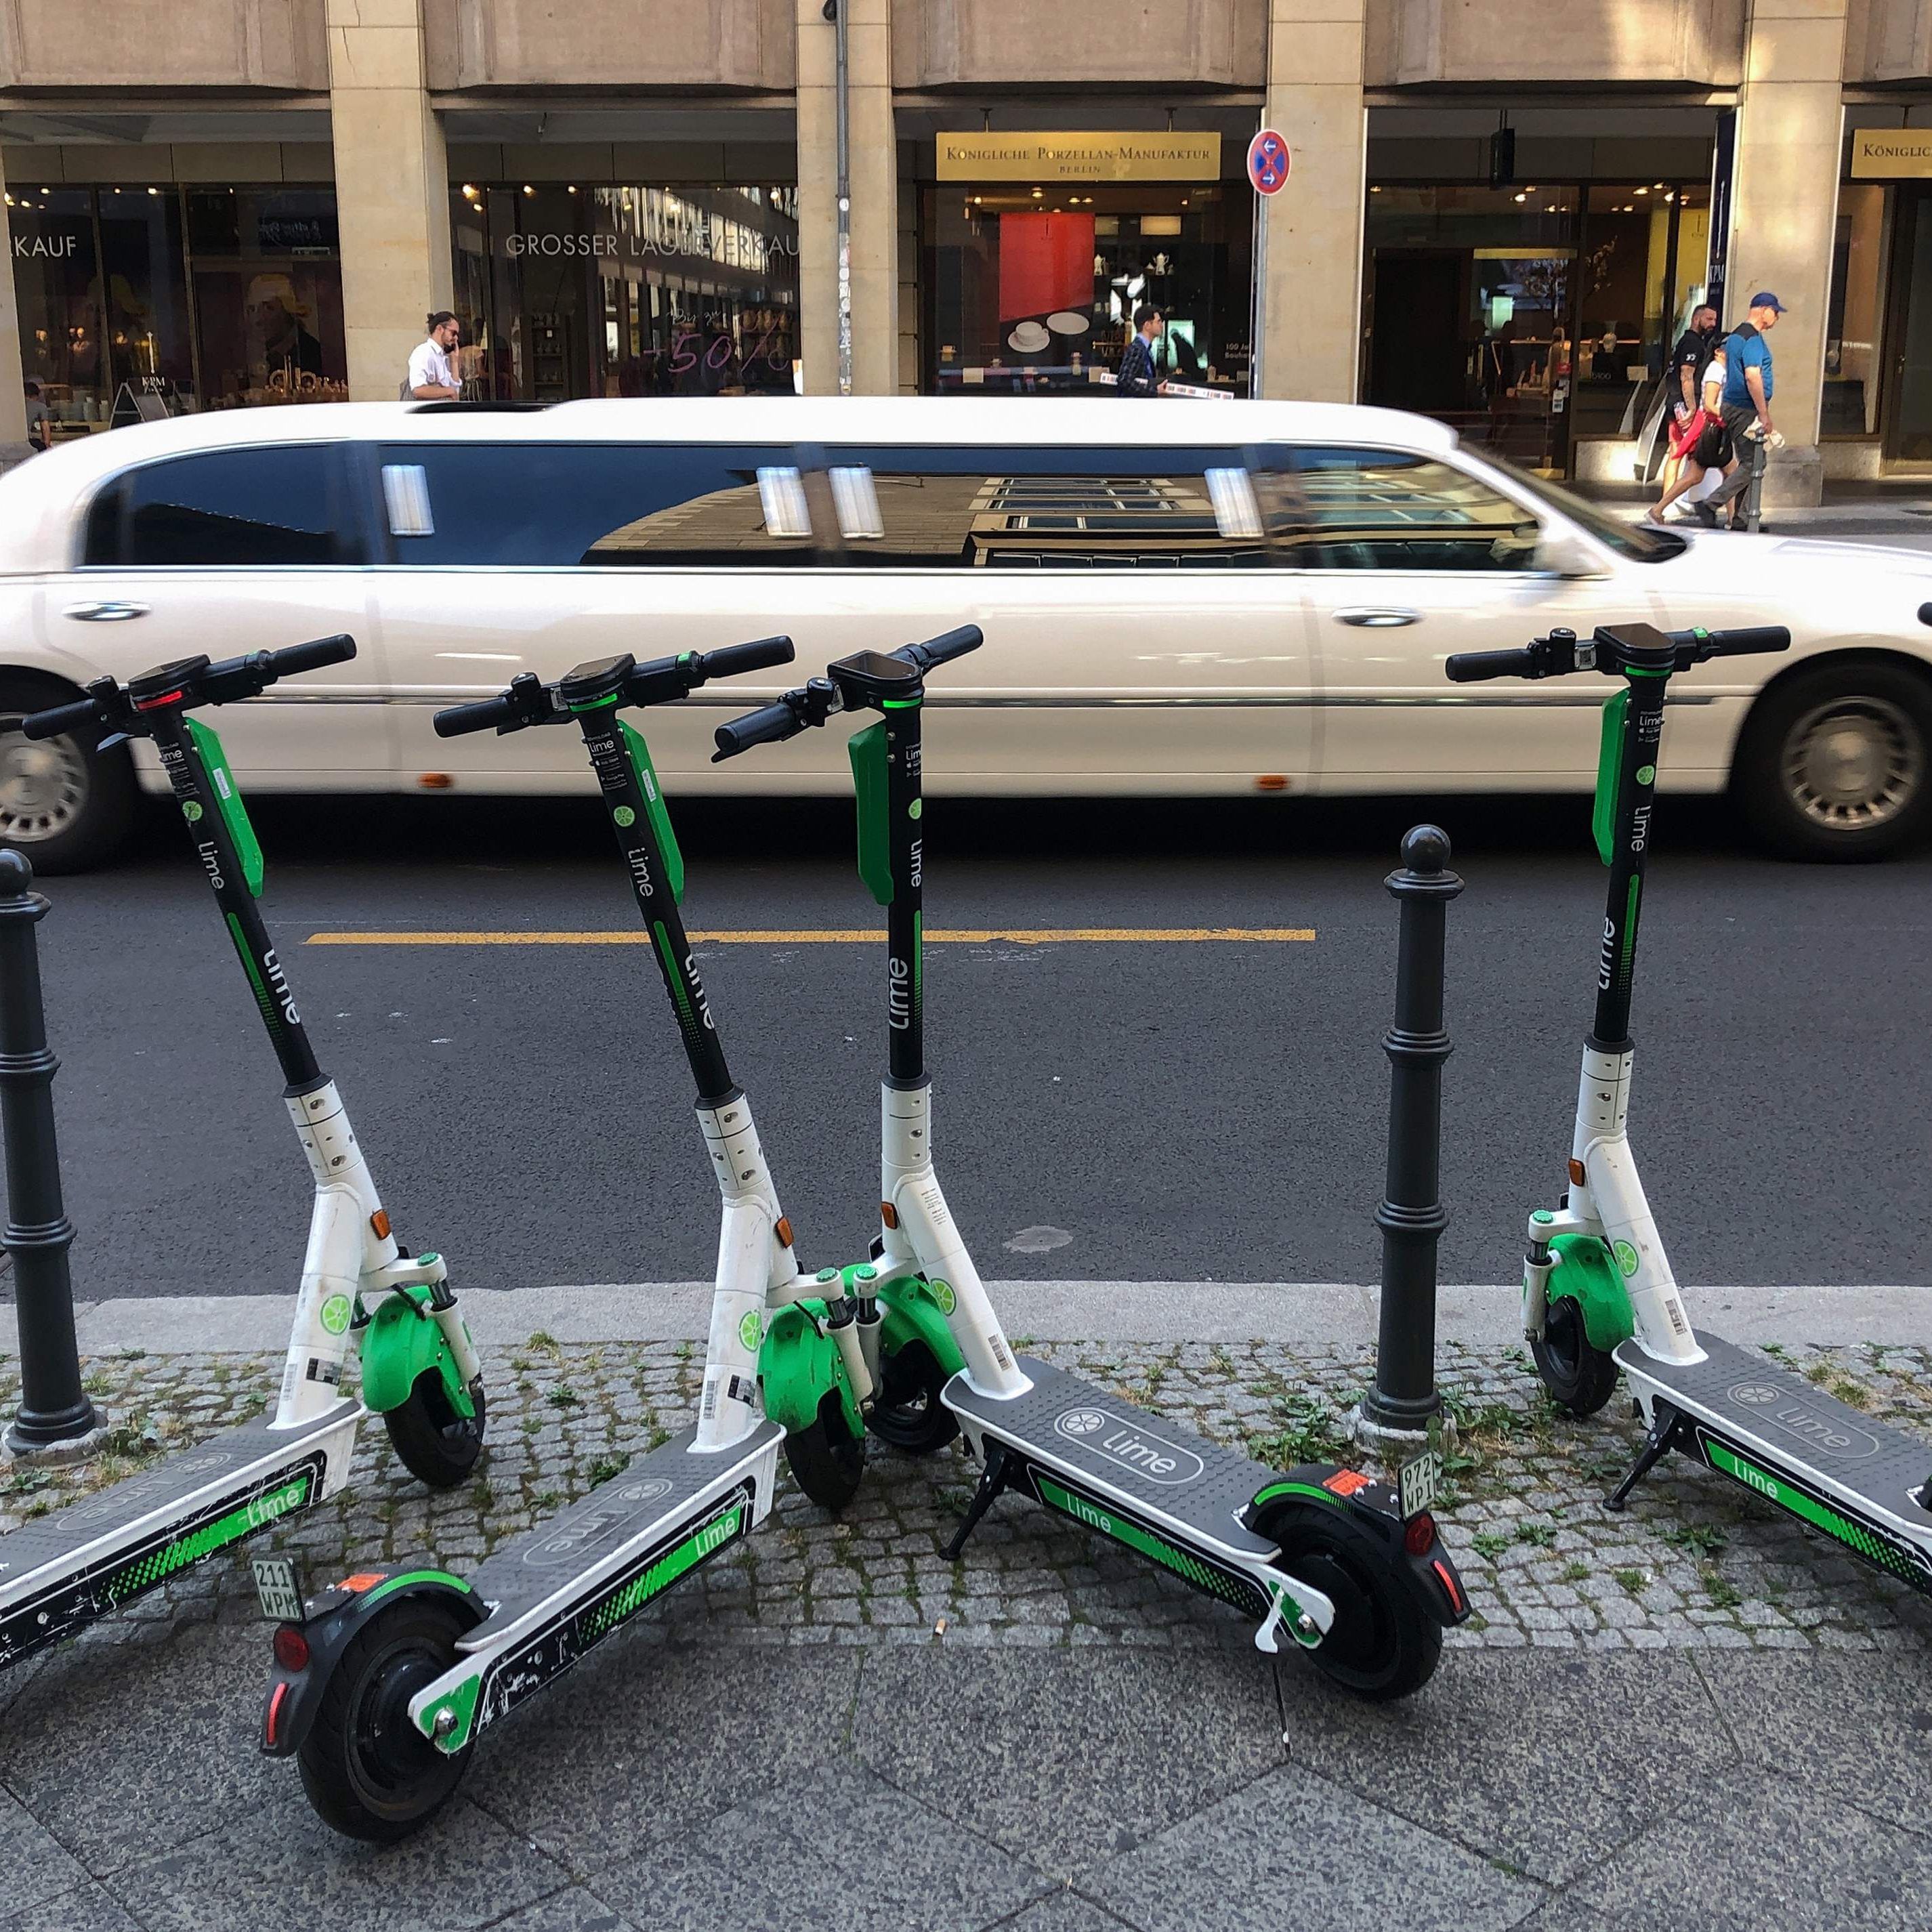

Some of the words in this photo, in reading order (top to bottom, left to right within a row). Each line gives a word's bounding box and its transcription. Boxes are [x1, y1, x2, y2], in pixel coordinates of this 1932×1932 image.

[1059, 165, 1101, 174] BERLIN
[505, 234, 618, 256] GROSSER
[1631, 805, 1651, 852] Lime
[198, 841, 224, 890] Lime
[627, 847, 654, 897] Lime
[910, 838, 923, 887] Lime
[264, 948, 301, 1024] Lime
[889, 957, 909, 1030] Lime
[1776, 1406, 1851, 1448] Lime
[1102, 1429, 1177, 1474] Lime
[1404, 1456, 1431, 1489] 972
[1406, 1479, 1432, 1513] WPI
[1734, 1456, 1779, 1500] Lime
[247, 1488, 300, 1528] Lime
[1066, 1492, 1112, 1534] Lime
[694, 1517, 736, 1557] Lime
[255, 1563, 290, 1588] 211
